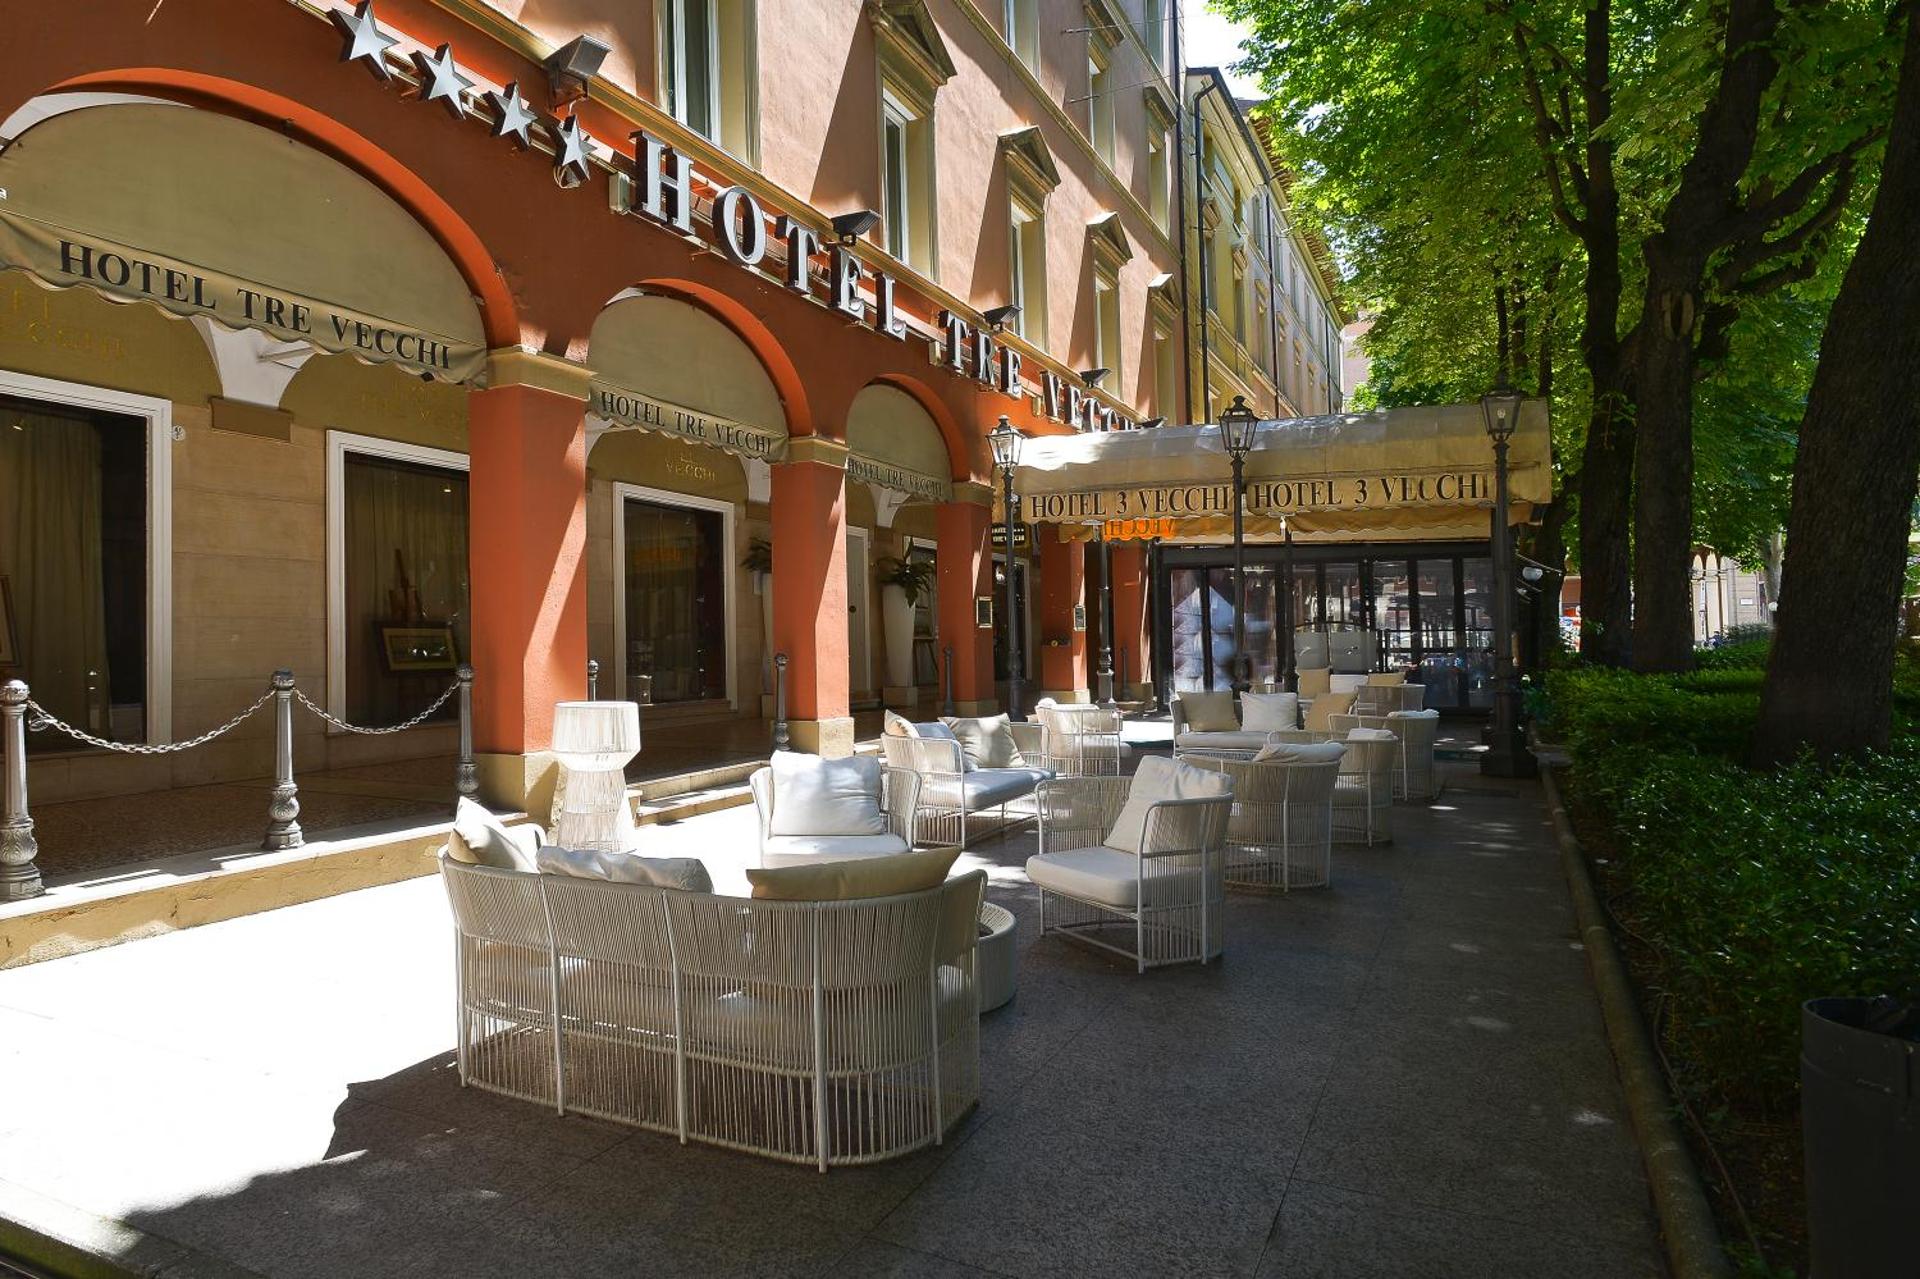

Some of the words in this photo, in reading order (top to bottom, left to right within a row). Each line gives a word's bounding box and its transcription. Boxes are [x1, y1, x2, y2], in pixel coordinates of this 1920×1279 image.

[58, 239, 217, 311] HOTEL
[237, 288, 312, 335] TRE
[330, 313, 450, 371] VECCHI
[630, 130, 907, 341] HOTEL
[939, 309, 1023, 398] TRE
[1040, 370, 1135, 433] VECC
[600, 391, 665, 427] HOTEL
[674, 411, 707, 438] TRE
[715, 423, 771, 454] VECCHI
[848, 458, 880, 480] HOTEL
[886, 469, 904, 487] TRE
[909, 474, 942, 497] VECCHI
[1032, 493, 1106, 518] HOTEL
[1117, 491, 1127, 514] 3
[1138, 486, 1229, 513] VECCHI
[1254, 480, 1342, 509] HOTEL
[1355, 479, 1368, 504] 3
[1380, 473, 1489, 502] VECCHI
